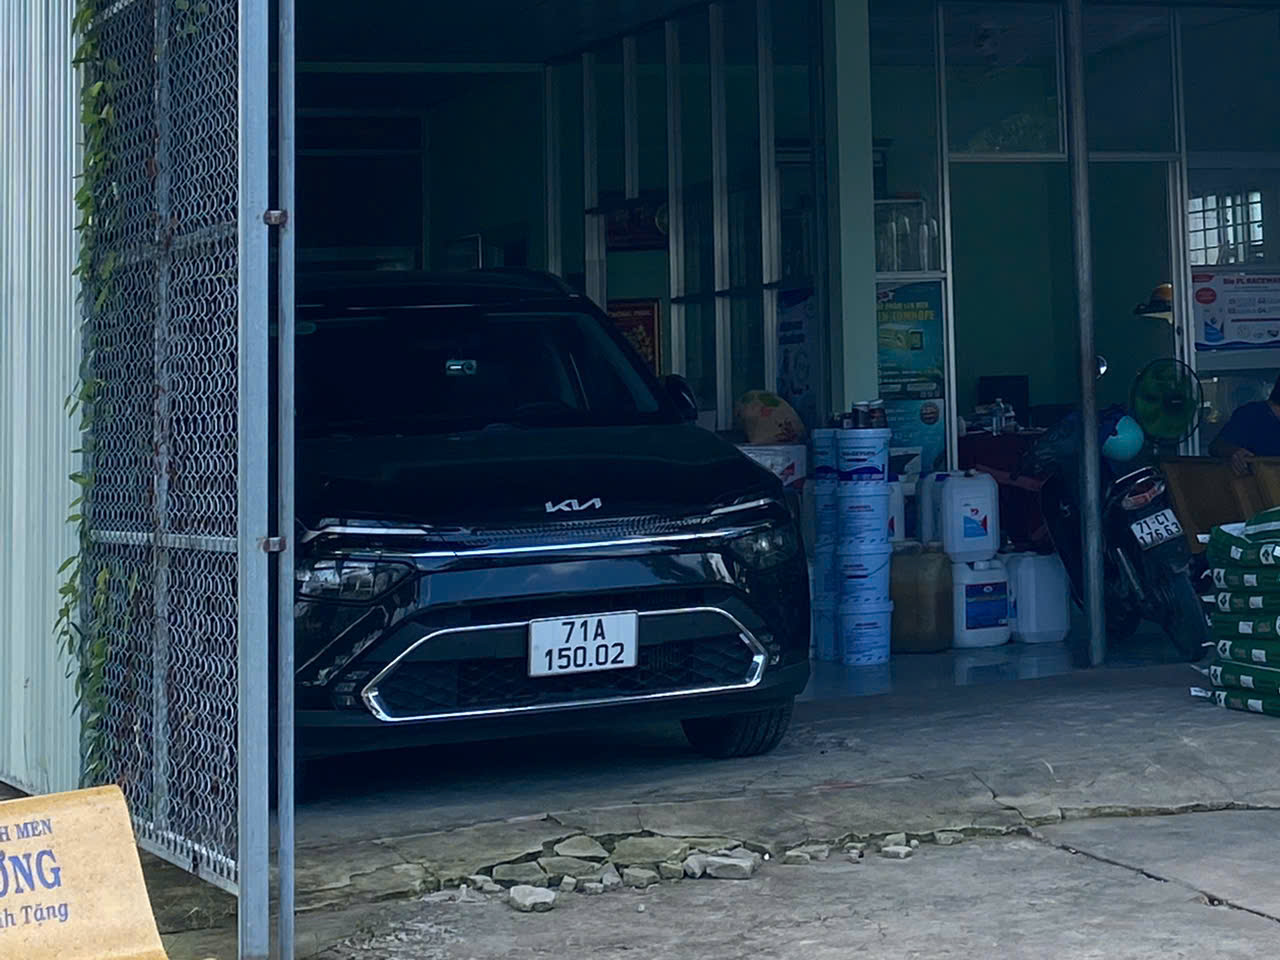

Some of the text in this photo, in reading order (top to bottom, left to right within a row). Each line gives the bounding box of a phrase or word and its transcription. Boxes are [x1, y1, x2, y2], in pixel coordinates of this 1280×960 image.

[545, 497, 602, 513] KIA
[1136, 512, 1169, 534] 71-C1
[1139, 521, 1181, 547] 176.63
[562, 618, 606, 643] 71A
[544, 642, 625, 671] 150.02
[20, 903, 69, 926] Tặng
